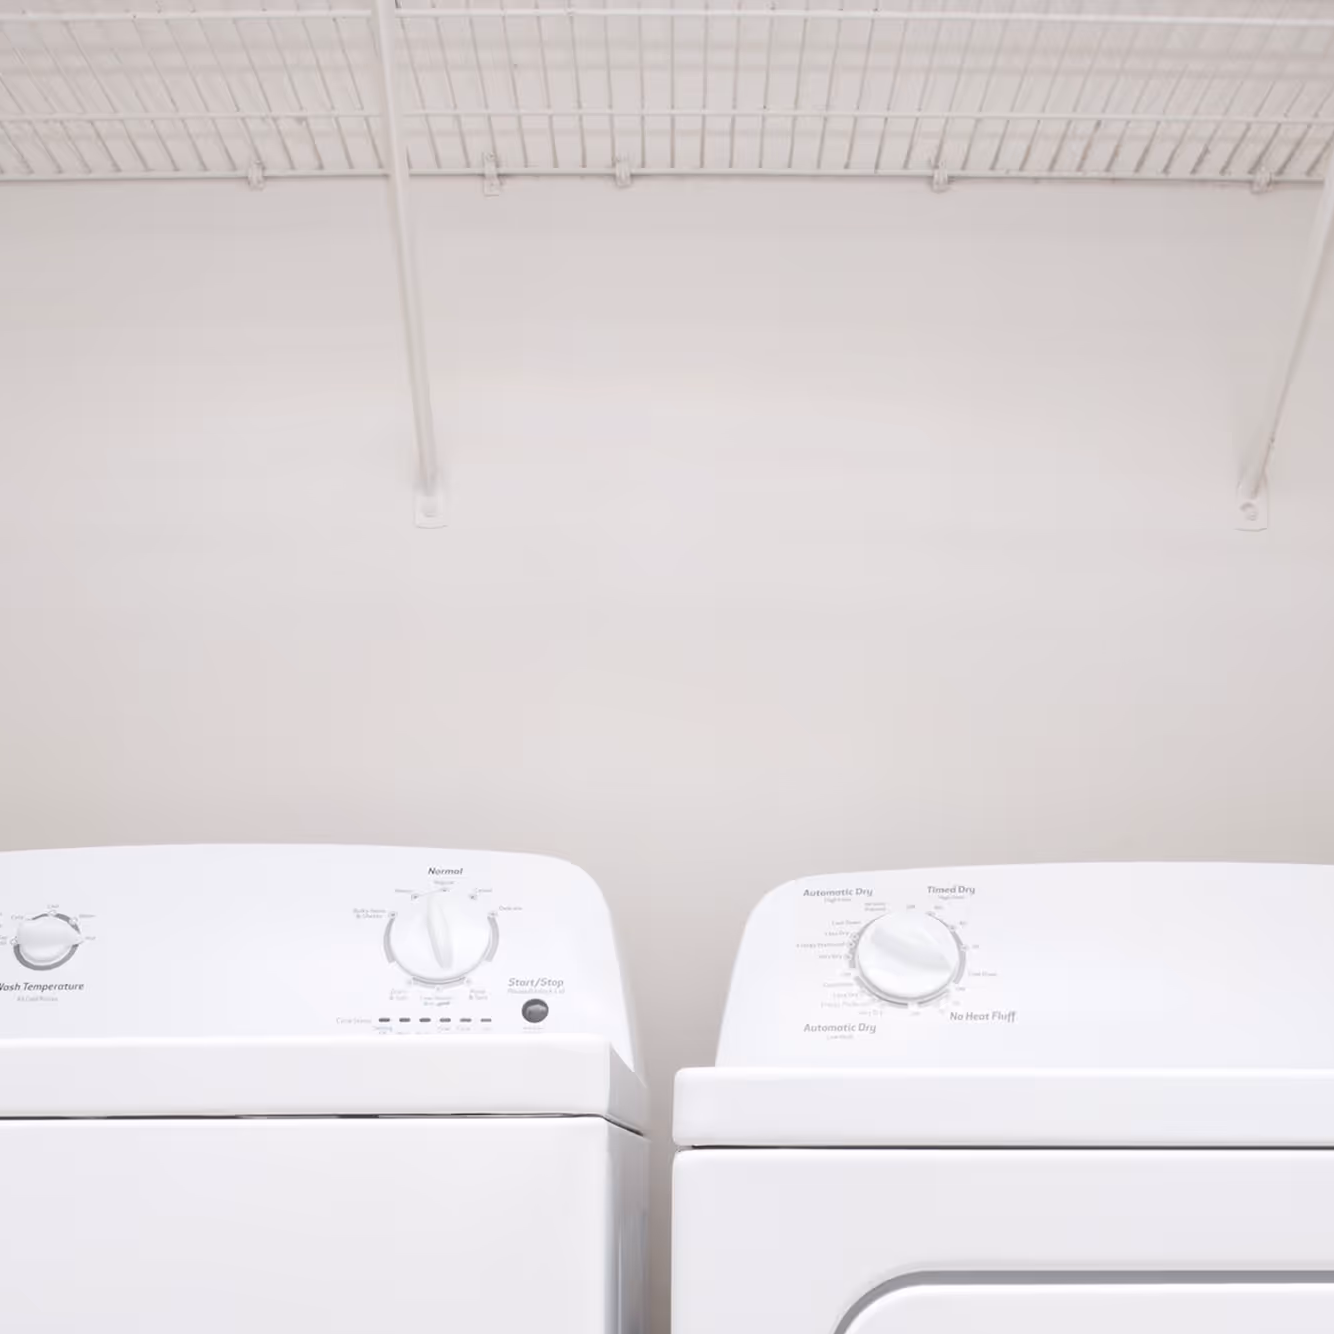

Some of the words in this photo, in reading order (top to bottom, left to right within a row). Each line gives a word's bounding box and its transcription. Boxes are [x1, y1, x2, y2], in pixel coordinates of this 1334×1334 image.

[427, 866, 464, 876] Normal
[803, 888, 854, 897] Automatic
[855, 887, 874, 897] Dry
[927, 885, 957, 895] Timed
[958, 885, 976, 895] Dry
[22, 981, 85, 994] Temperature
[507, 977, 565, 989] Start/Stop
[949, 1012, 964, 1022] No
[965, 1011, 990, 1021] Heat
[991, 1010, 1017, 1023] Fluff
[803, 1023, 855, 1033] Automatic
[857, 1023, 877, 1034] Dry
